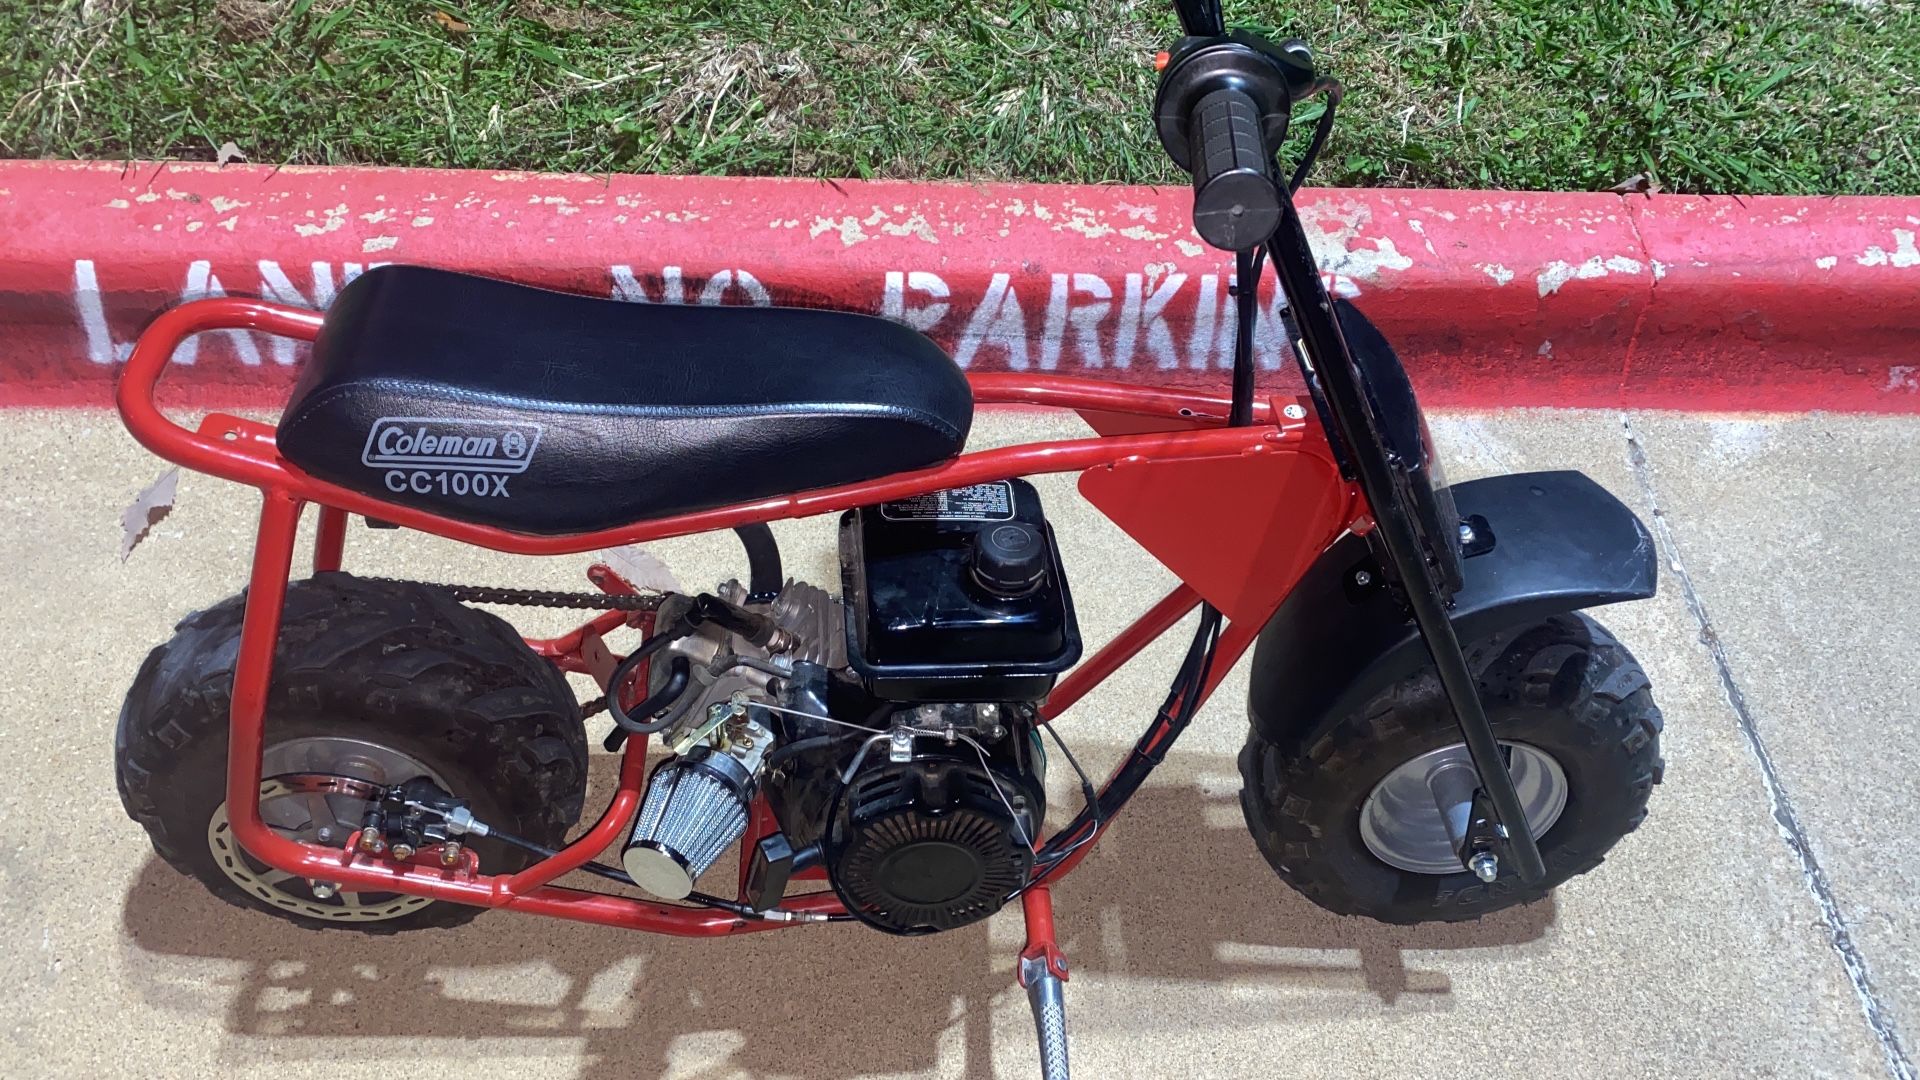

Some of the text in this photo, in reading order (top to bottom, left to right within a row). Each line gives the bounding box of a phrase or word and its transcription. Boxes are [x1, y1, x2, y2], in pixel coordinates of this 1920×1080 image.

[74, 260, 1362, 371] LAN PARKIN
[378, 427, 497, 457] Coleman
[385, 470, 510, 498] CC100X
